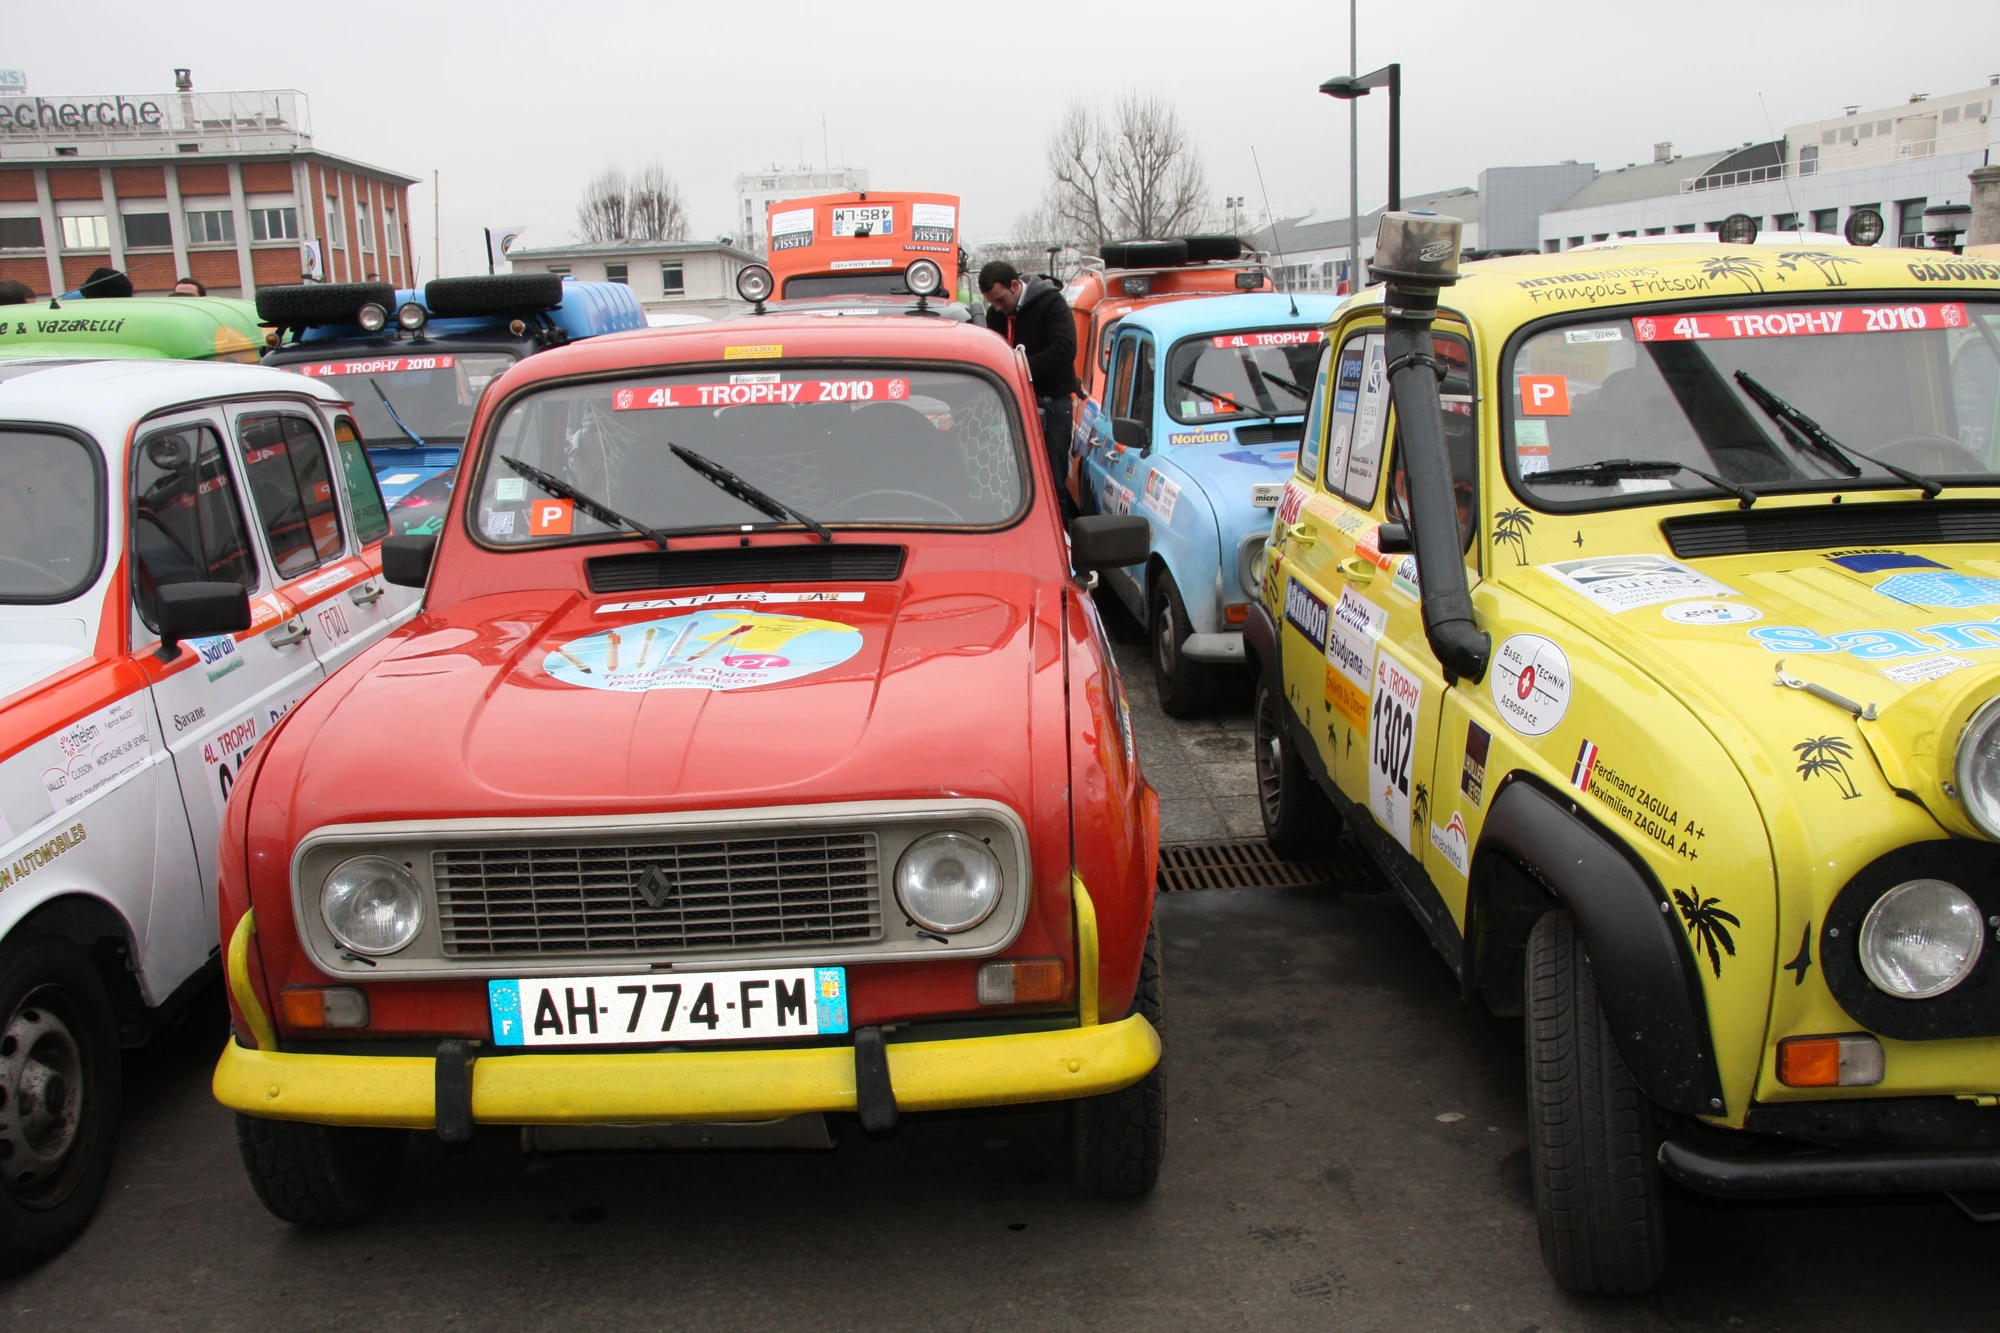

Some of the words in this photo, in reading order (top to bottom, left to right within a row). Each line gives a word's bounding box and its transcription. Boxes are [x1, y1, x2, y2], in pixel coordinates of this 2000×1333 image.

[774, 235, 813, 251] ALESSIA
[914, 230, 953, 244] ALESSIA
[1420, 243, 1443, 254] TOP
[1433, 247, 1454, 258] SPIN
[1527, 280, 1627, 303] François
[1630, 274, 1710, 296] Fritsch
[16, 322, 27, 335] &
[1673, 317, 1711, 339] 4L
[1726, 311, 1843, 337] TROPHY
[1862, 307, 1926, 331] 2010
[1231, 335, 1249, 347] 4L
[1256, 332, 1309, 346] TROPHY
[319, 365, 336, 376] 4L
[344, 360, 400, 374] TROPHY
[406, 357, 436, 370] 2010
[648, 389, 680, 407] 4L
[697, 383, 803, 404] TROPHY
[819, 381, 874, 400] 2010
[1532, 384, 1555, 406] P
[1171, 432, 1229, 445] Norauto
[1255, 494, 1279, 503] micro
[541, 506, 563, 528] P
[1594, 577, 1708, 594] eurex
[1285, 581, 1326, 645] samson
[1684, 608, 1728, 618] gan
[199, 639, 223, 665] Sidi
[221, 634, 236, 656] ali
[1503, 645, 1523, 665] BASEL
[701, 667, 769, 679] Objets
[1536, 663, 1567, 691] TECHNIK
[1378, 660, 1387, 685] 4L
[1390, 667, 1420, 710] TROPHY
[173, 706, 206, 731] Savane
[1501, 694, 1538, 727] AEROSPACE
[204, 743, 219, 765] 4L
[217, 717, 256, 756] TROPHY
[1373, 688, 1413, 797] 1302
[46, 776, 68, 792] VALLET
[71, 762, 94, 780] CLISSON
[96, 733, 149, 767] MORTAGNE-SUR-SEVRE
[1593, 759, 1638, 798] Ferdinand
[1636, 788, 1678, 826] ZAGULA
[1684, 820, 1706, 840] A+
[1587, 778, 1633, 821] Maximilien
[1634, 811, 1675, 850] ZAGULA
[1677, 841, 1698, 861] A+
[13, 823, 87, 882] AUTOMOBILES
[1431, 828, 1462, 870] ArcelorMittal
[533, 977, 808, 1036] AH-774-FM
[820, 1005, 845, 1027] 84
[502, 1019, 513, 1035] F
